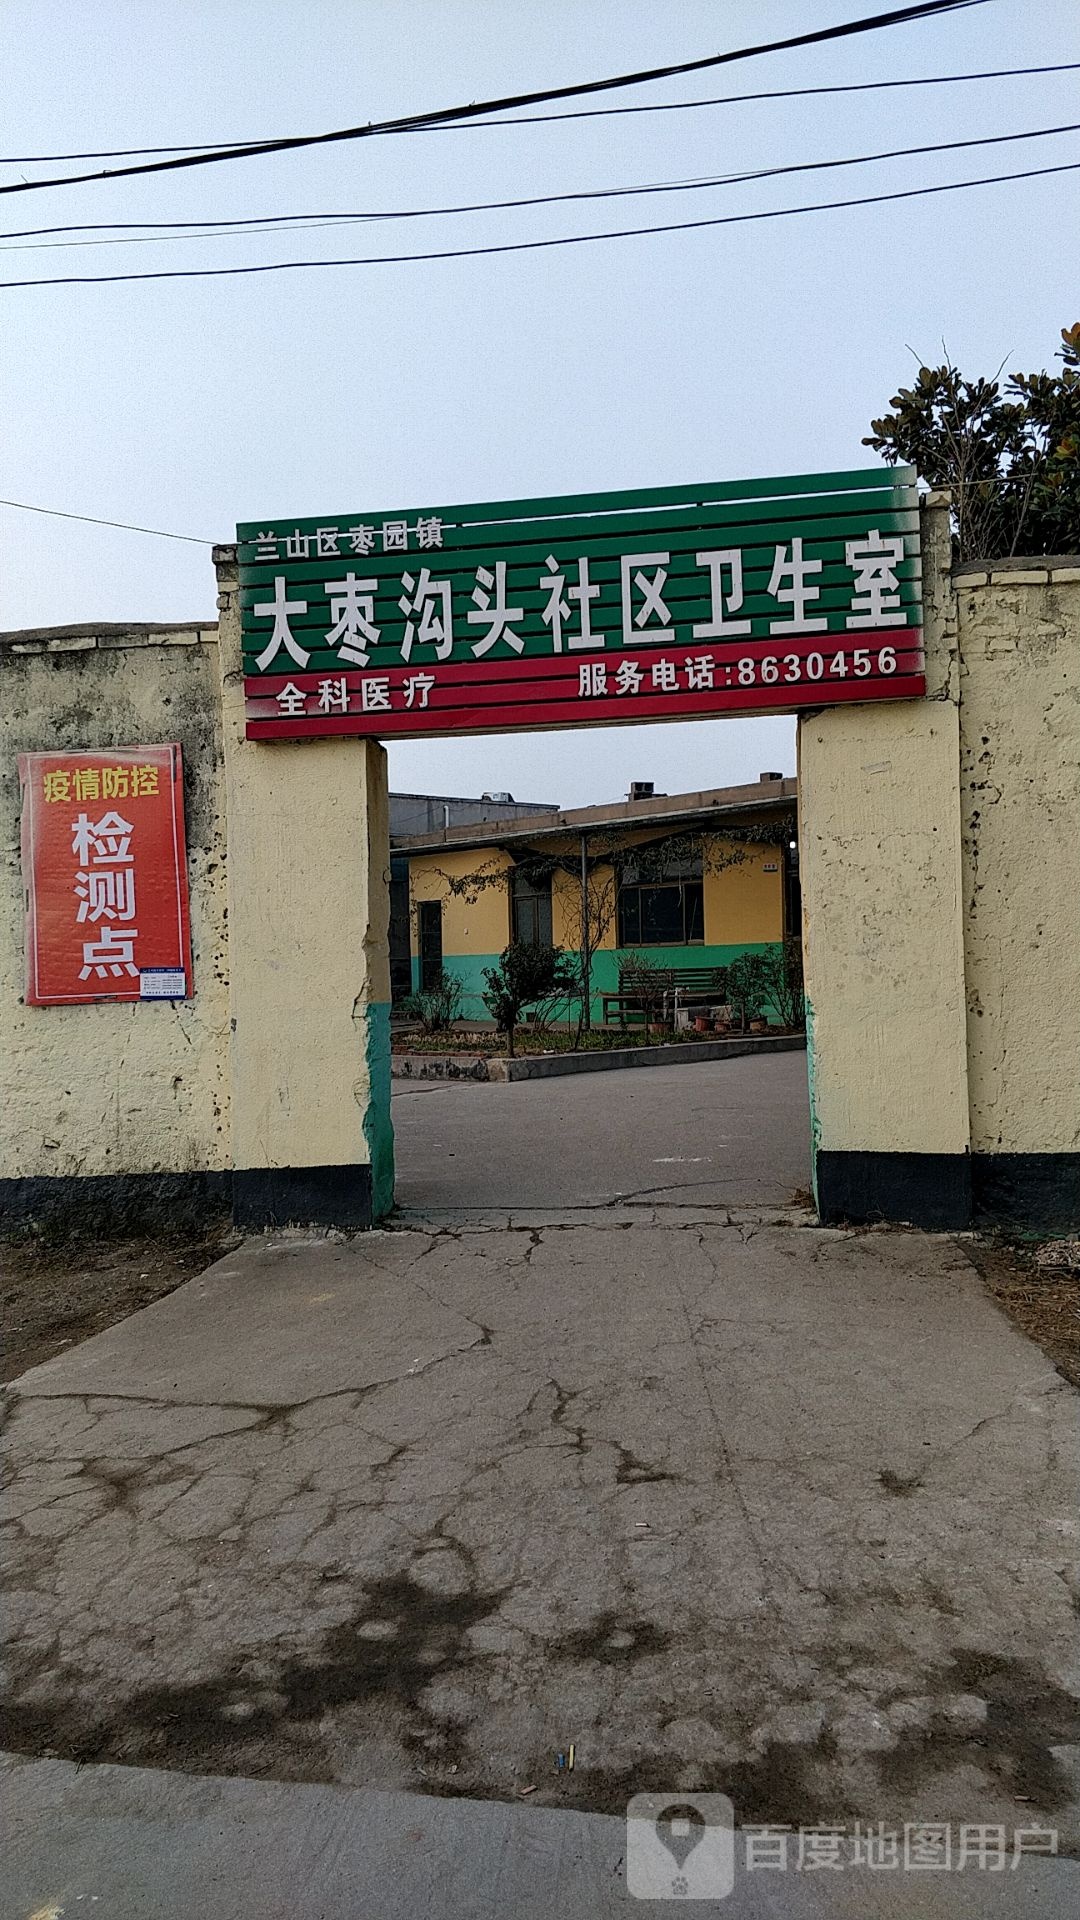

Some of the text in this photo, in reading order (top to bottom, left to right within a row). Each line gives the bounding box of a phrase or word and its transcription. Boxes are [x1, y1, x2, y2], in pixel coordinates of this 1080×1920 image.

[254, 516, 444, 561] 兰山区枣园镇
[253, 530, 908, 673] 大枣沟头社区卫生室
[275, 672, 436, 717] 全科医疗
[577, 646, 897, 697] 服务电话:8630456
[43, 765, 160, 803] 疫情防控
[71, 811, 140, 981] 检测点
